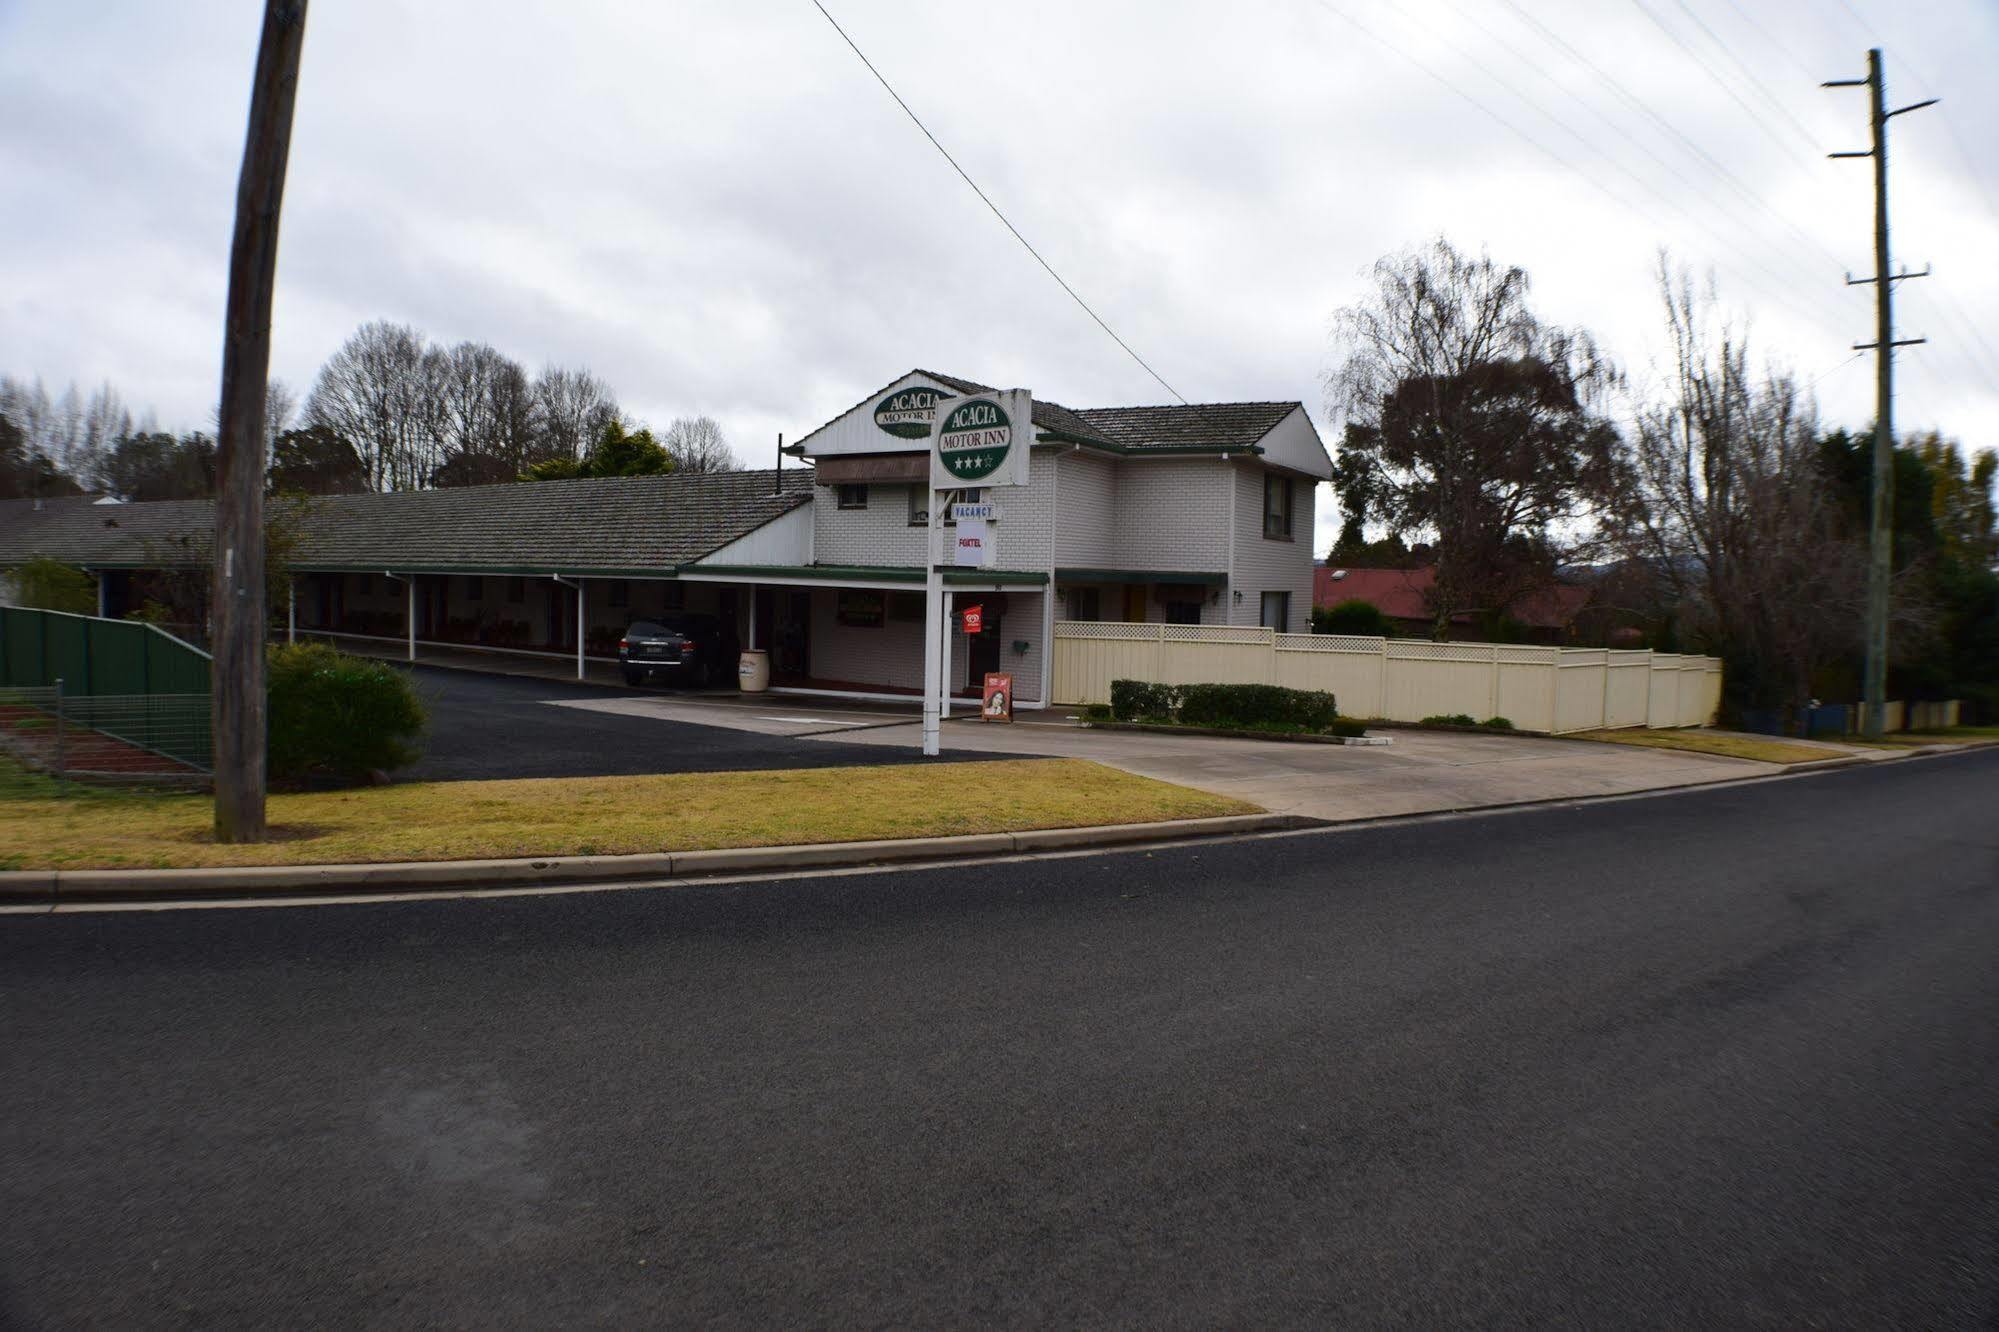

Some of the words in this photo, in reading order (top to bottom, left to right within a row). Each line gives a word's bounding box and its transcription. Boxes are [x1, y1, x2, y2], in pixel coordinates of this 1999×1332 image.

[890, 392, 940, 410] ACACIA
[883, 411, 923, 422] MOTOR
[952, 406, 997, 428] ACACIA
[943, 433, 981, 449] MOTOR
[984, 430, 1006, 444] INN
[955, 506, 992, 517] VACANCY
[958, 538, 981, 547] FOXTEL
